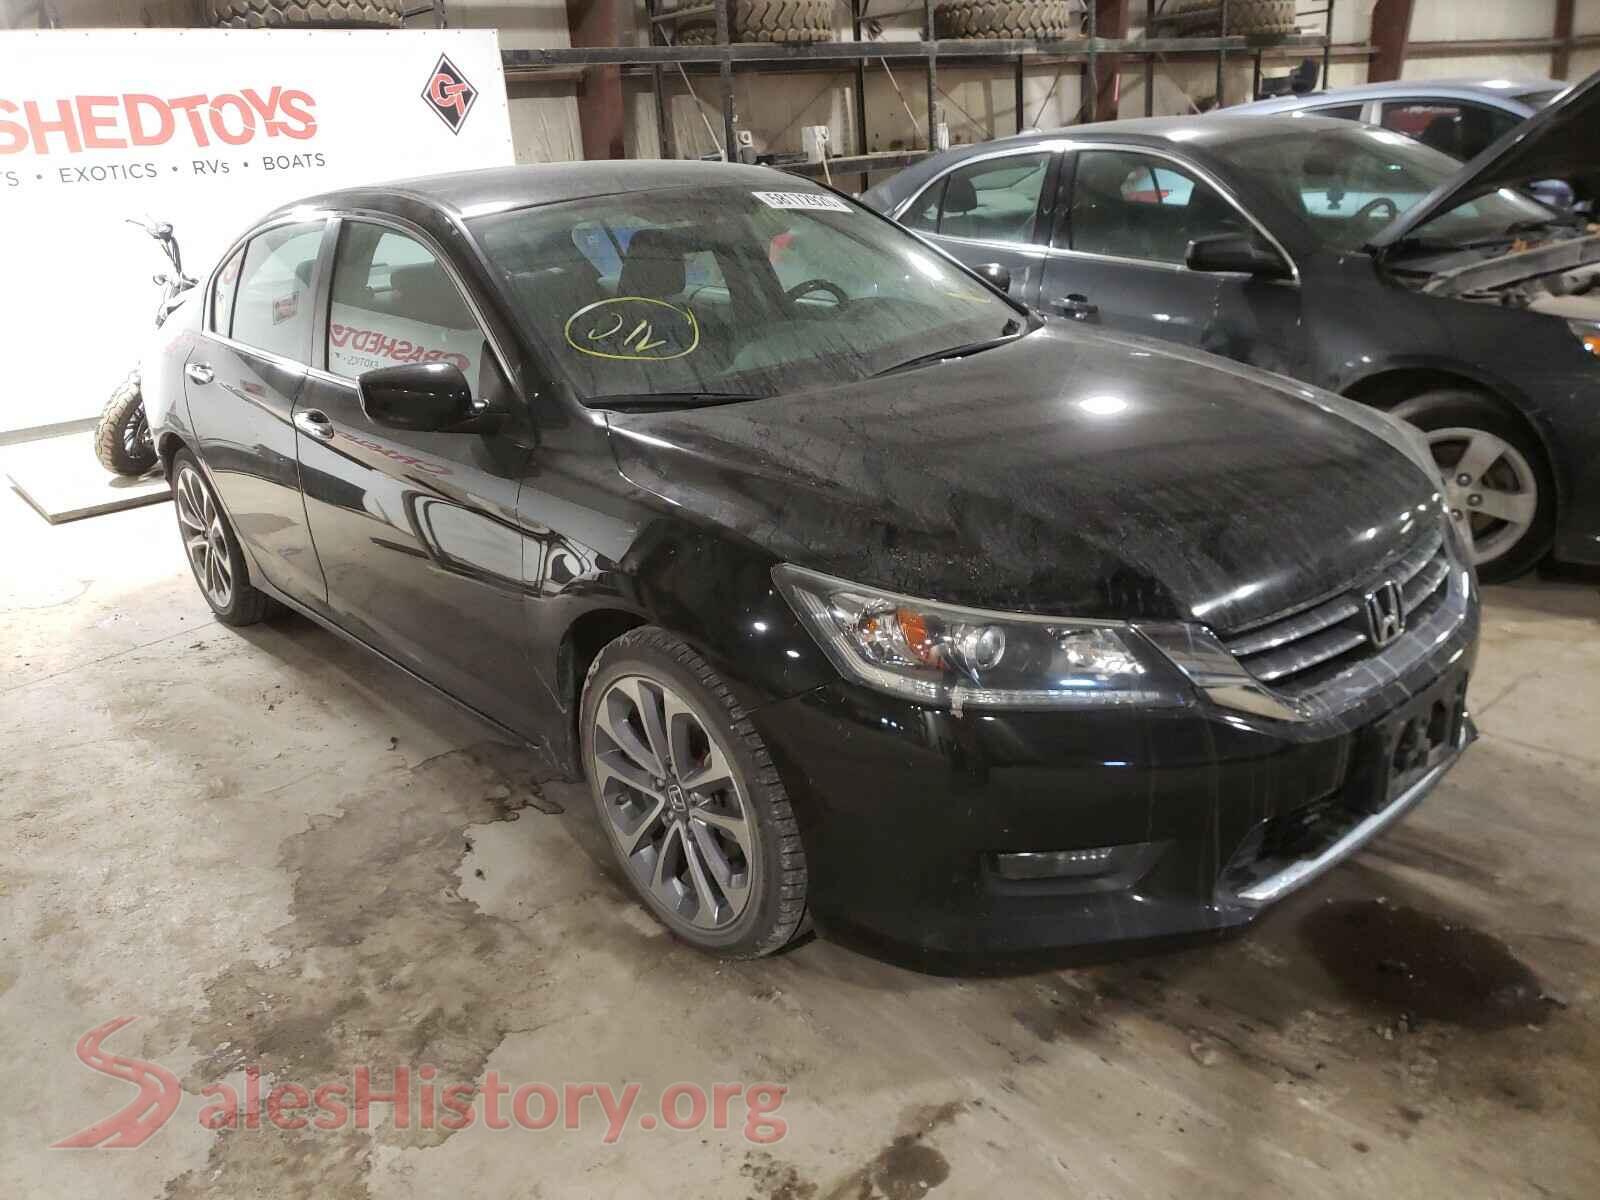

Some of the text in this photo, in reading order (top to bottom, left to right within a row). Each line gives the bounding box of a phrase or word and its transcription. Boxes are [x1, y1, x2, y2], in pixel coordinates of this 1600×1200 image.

[59, 163, 157, 183] EXOTICS
[193, 160, 230, 174] RVs
[263, 152, 325, 170] BOATS
